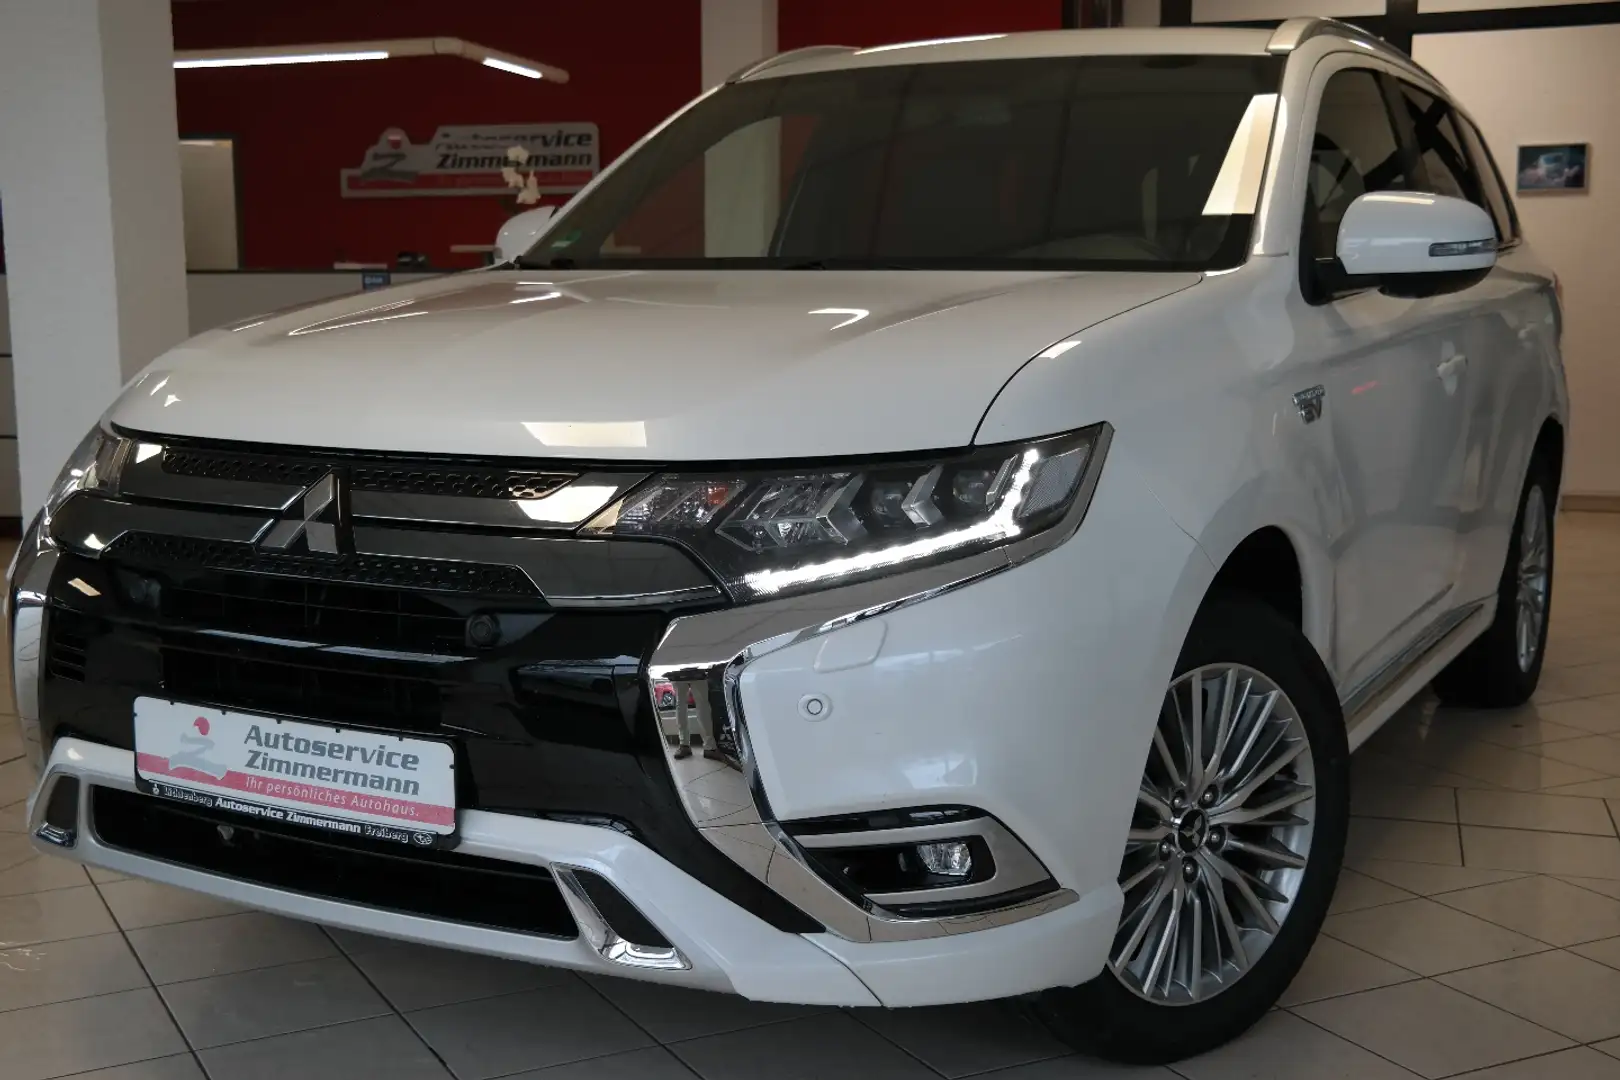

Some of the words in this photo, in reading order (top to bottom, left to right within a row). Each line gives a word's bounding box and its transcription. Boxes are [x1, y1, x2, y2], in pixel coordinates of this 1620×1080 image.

[436, 152, 593, 169] Zimmmann
[243, 724, 420, 771] Autoservice
[244, 750, 420, 796] Zimmermann
[215, 797, 284, 819] Autoservice
[286, 811, 361, 834] Zimmermann
[245, 776, 263, 790] Ihr
[266, 780, 346, 805] persönliches
[351, 797, 420, 817] Autohaus.
